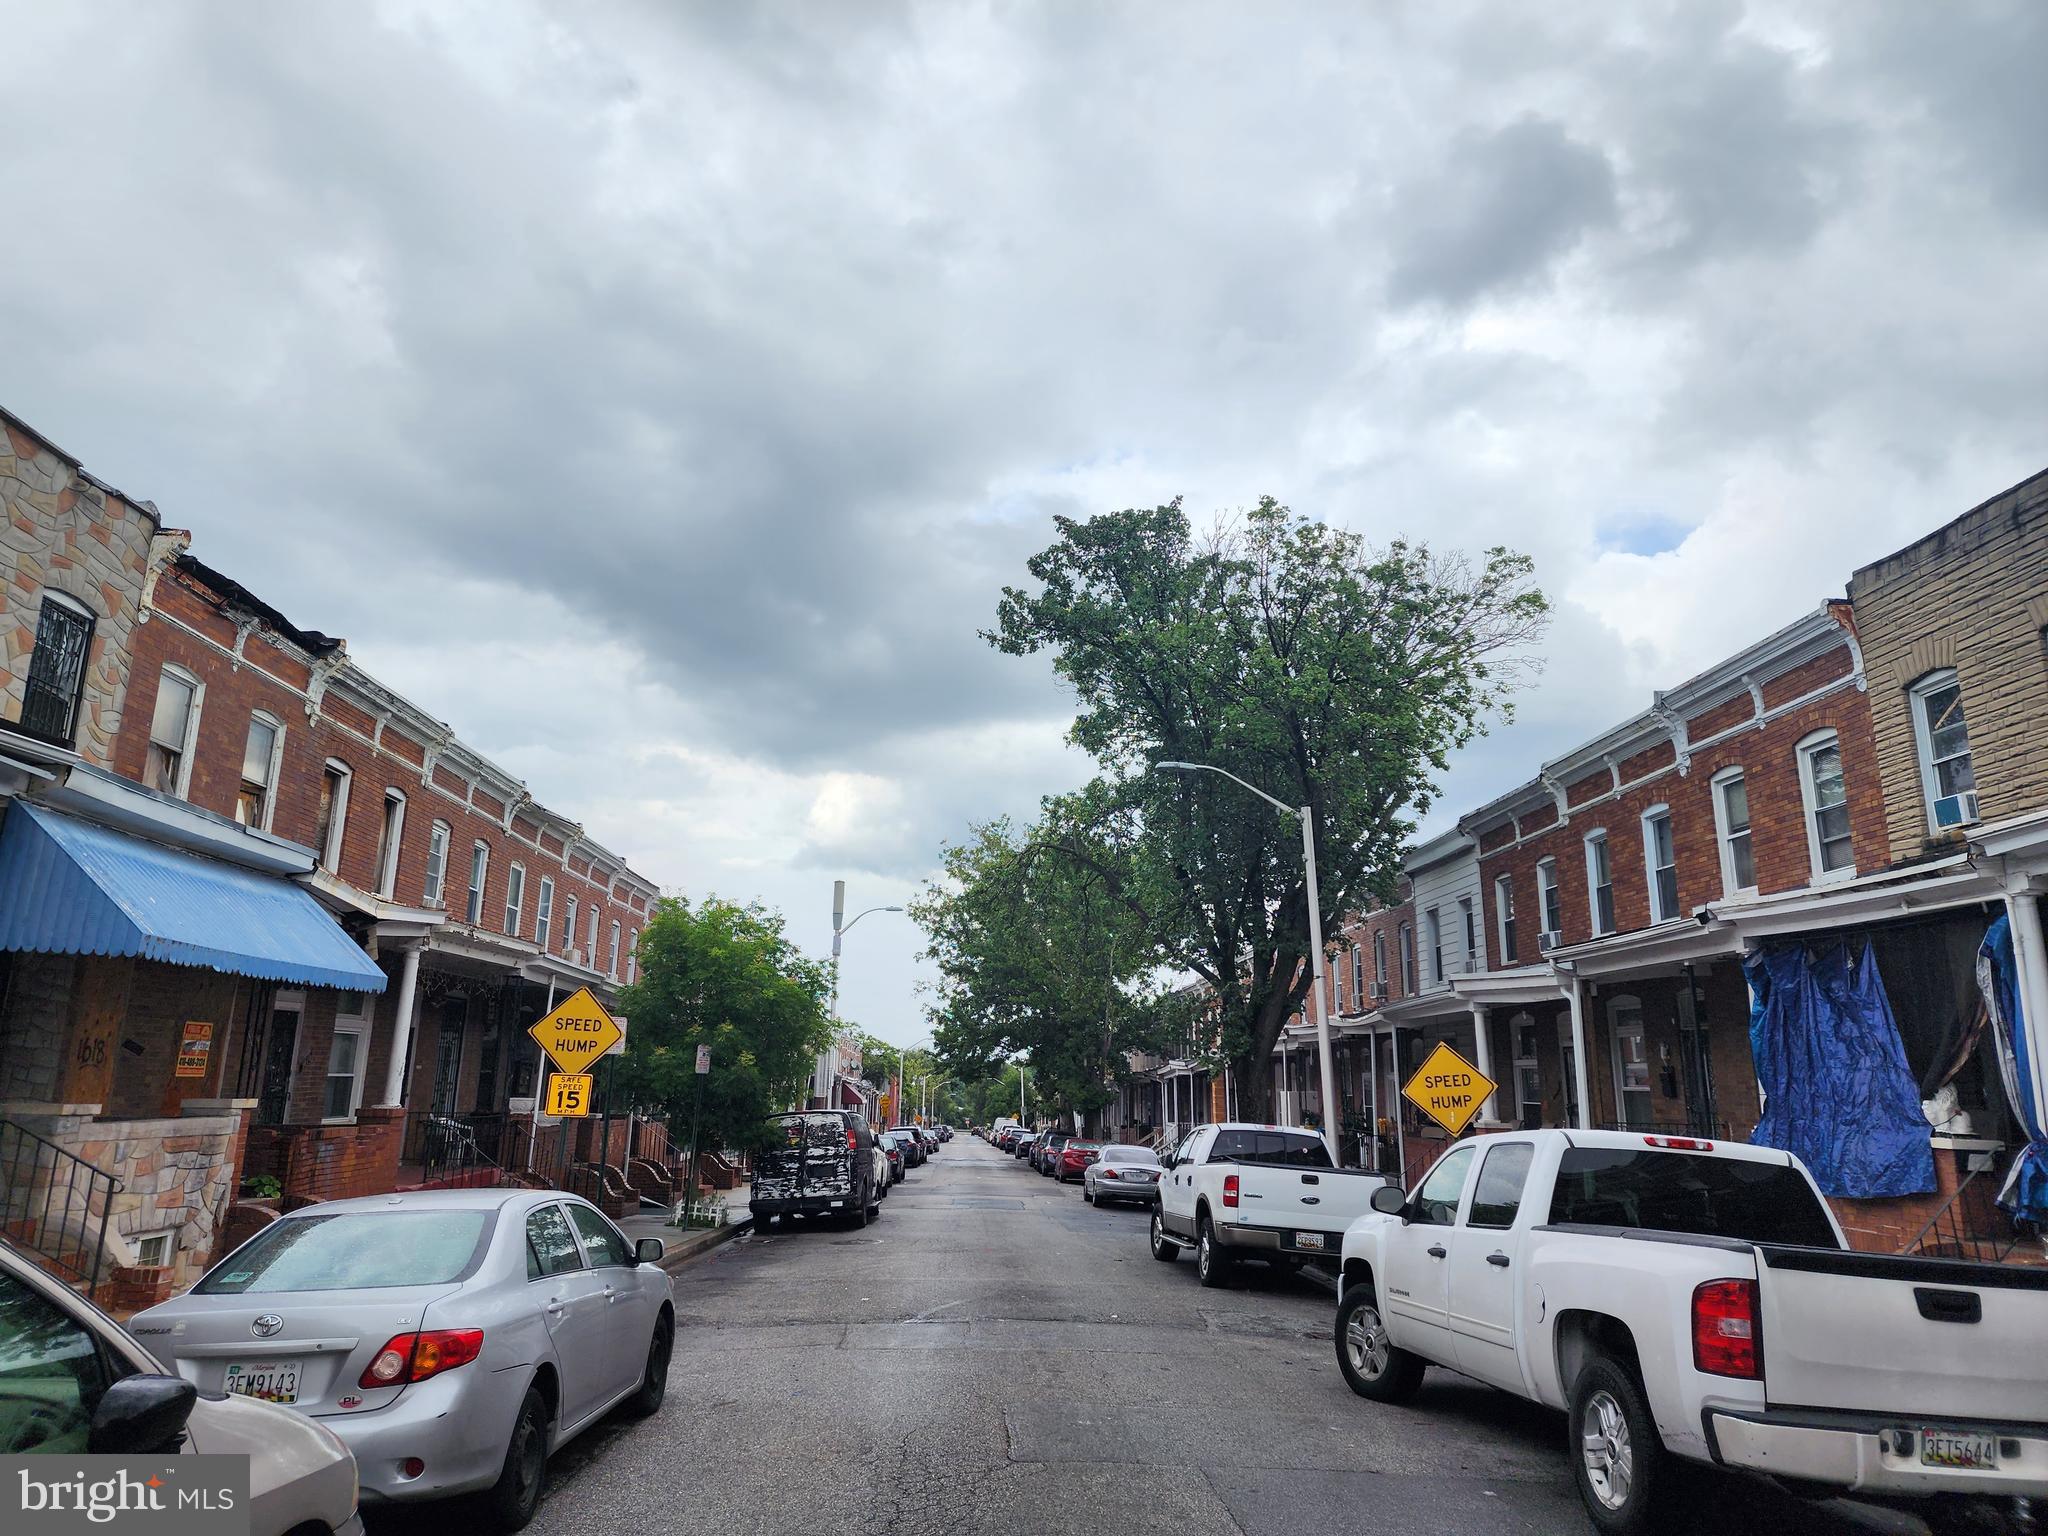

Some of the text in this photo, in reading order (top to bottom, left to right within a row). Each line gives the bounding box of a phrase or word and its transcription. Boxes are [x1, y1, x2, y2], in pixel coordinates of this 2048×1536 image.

[554, 1017, 602, 1032] SPEED
[77, 1036, 105, 1065] 1618
[555, 1038, 598, 1053] HUMP
[557, 1083, 584, 1091] SPEED
[1424, 1073, 1471, 1089] SPEED
[557, 1091, 580, 1109] 15
[1431, 1094, 1472, 1109] HUMP
[226, 1372, 297, 1397] 3EM9143
[343, 1397, 358, 1406] PL
